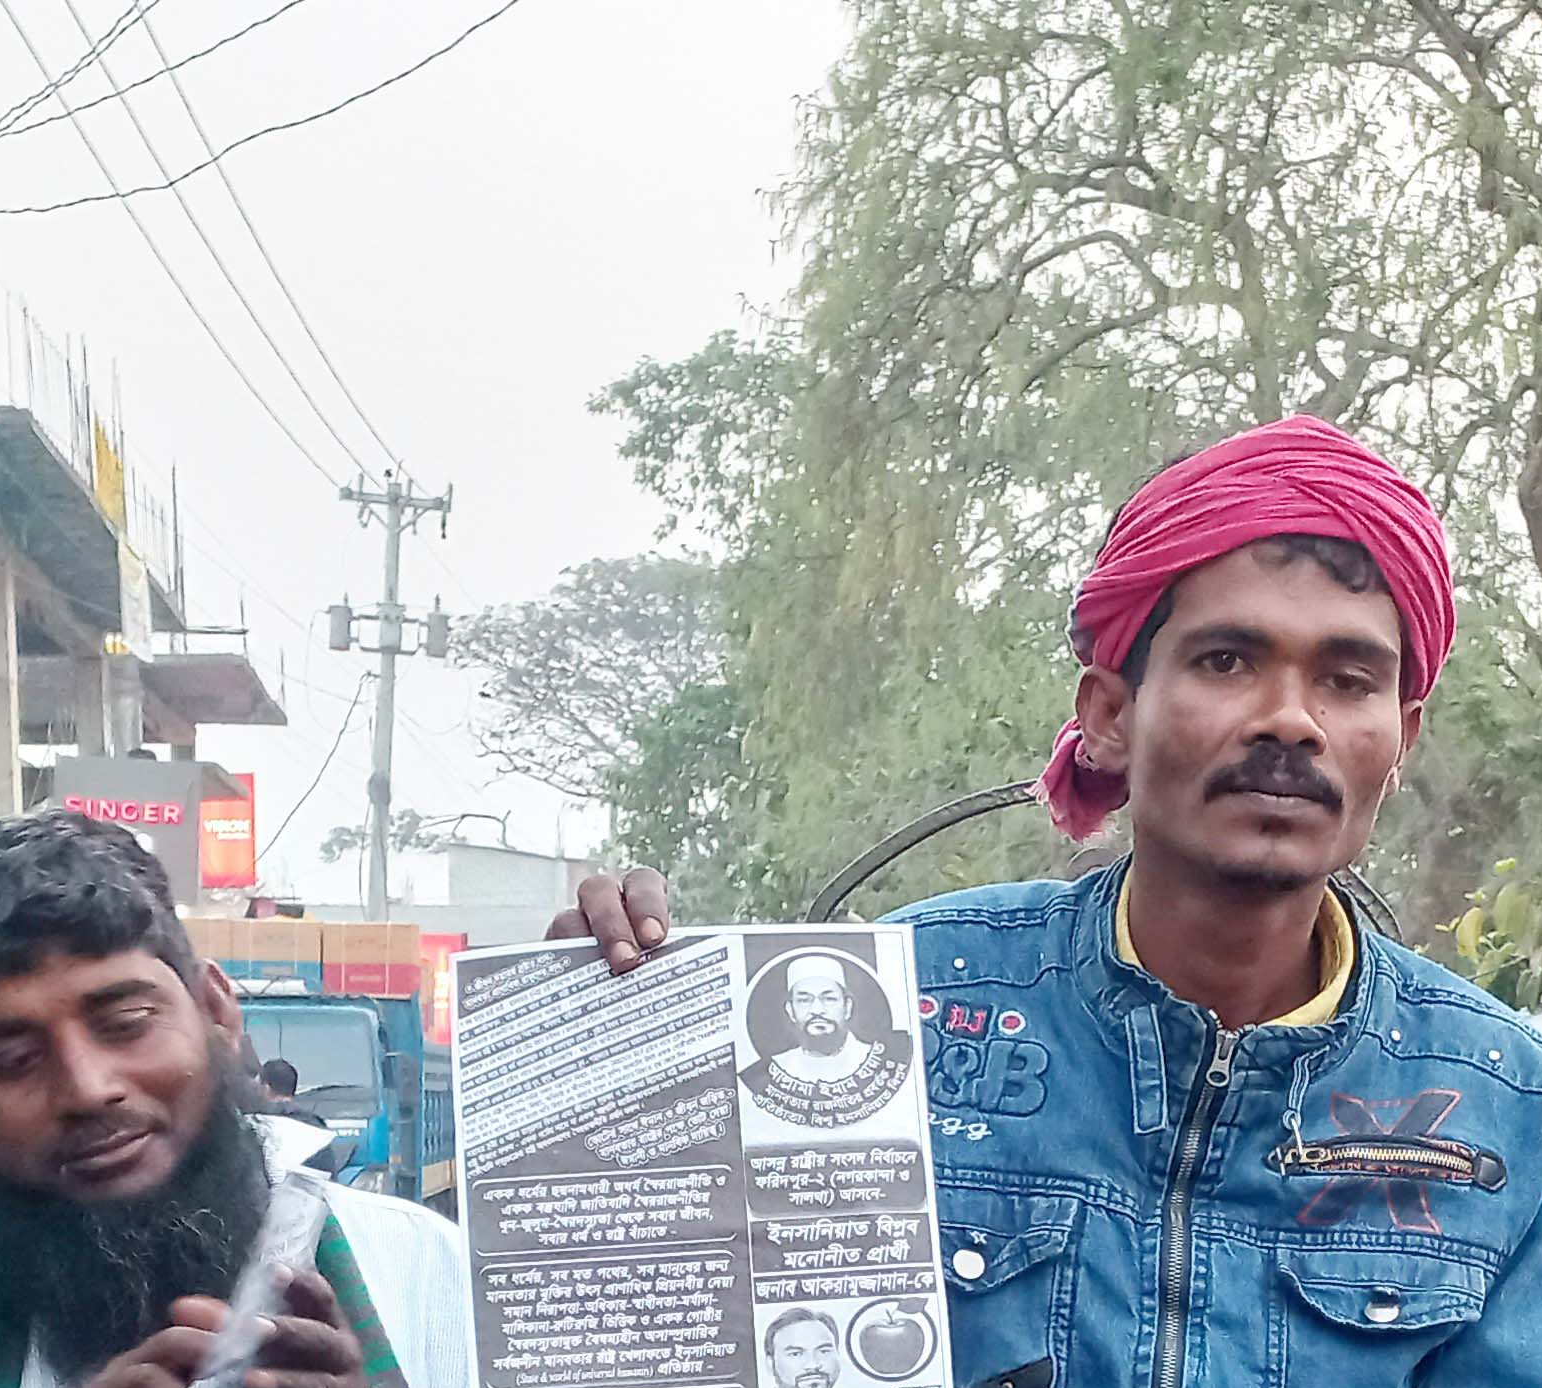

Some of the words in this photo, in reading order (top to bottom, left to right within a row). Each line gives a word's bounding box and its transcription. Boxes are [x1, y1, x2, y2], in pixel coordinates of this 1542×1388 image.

[63, 796, 182, 824] SINGER
[766, 1218, 871, 1245] ইনসানিয়াত
[875, 1214, 921, 1238] বিপ্লব
[782, 1243, 864, 1269] মনোনীত
[866, 1237, 911, 1263] প্রার্থী
[756, 1279, 798, 1300] জনাব
